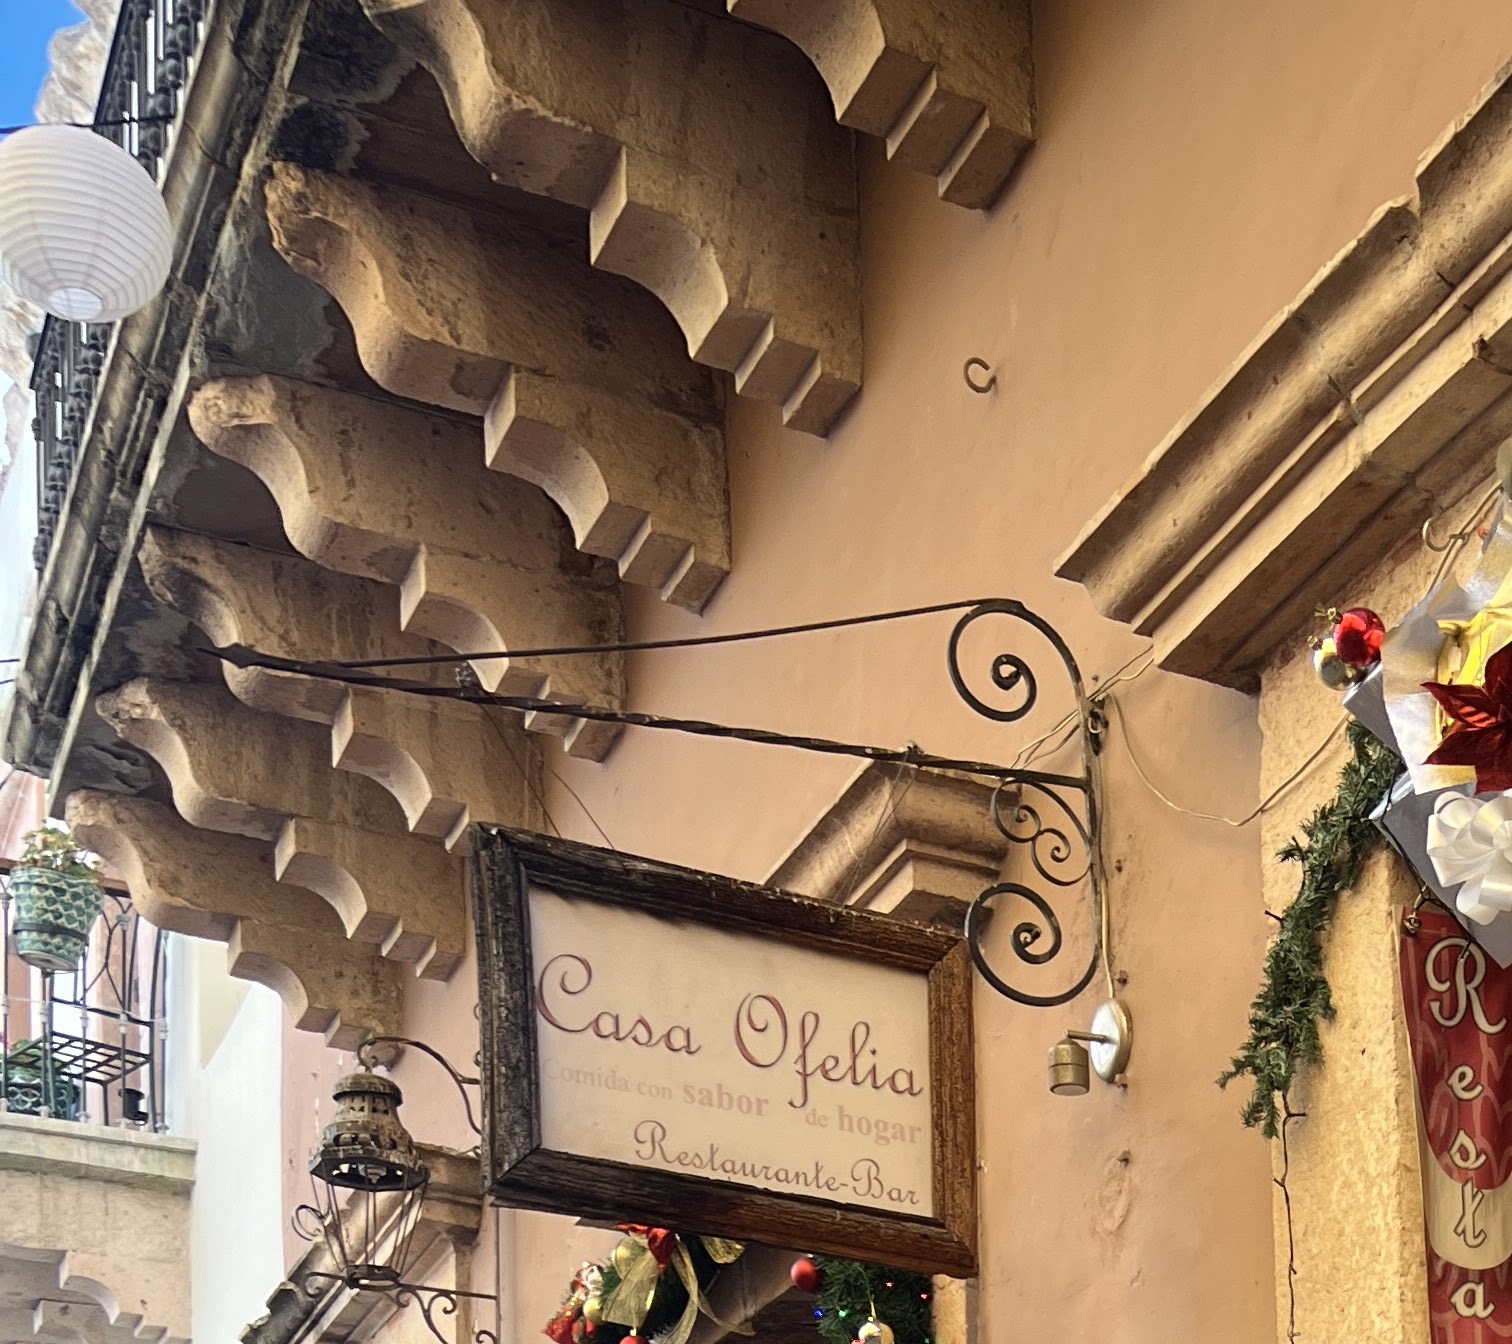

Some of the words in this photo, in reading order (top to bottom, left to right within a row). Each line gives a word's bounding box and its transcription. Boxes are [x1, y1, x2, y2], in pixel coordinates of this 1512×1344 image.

[538, 953, 702, 1056] Casa
[734, 992, 924, 1109] Ofelia
[543, 1057, 631, 1093] Comida
[637, 1080, 673, 1101] con
[682, 1082, 769, 1116] sabor
[805, 1105, 829, 1128] de
[837, 1110, 923, 1149] hogar
[632, 1120, 921, 1206] Restaurante-Bar
